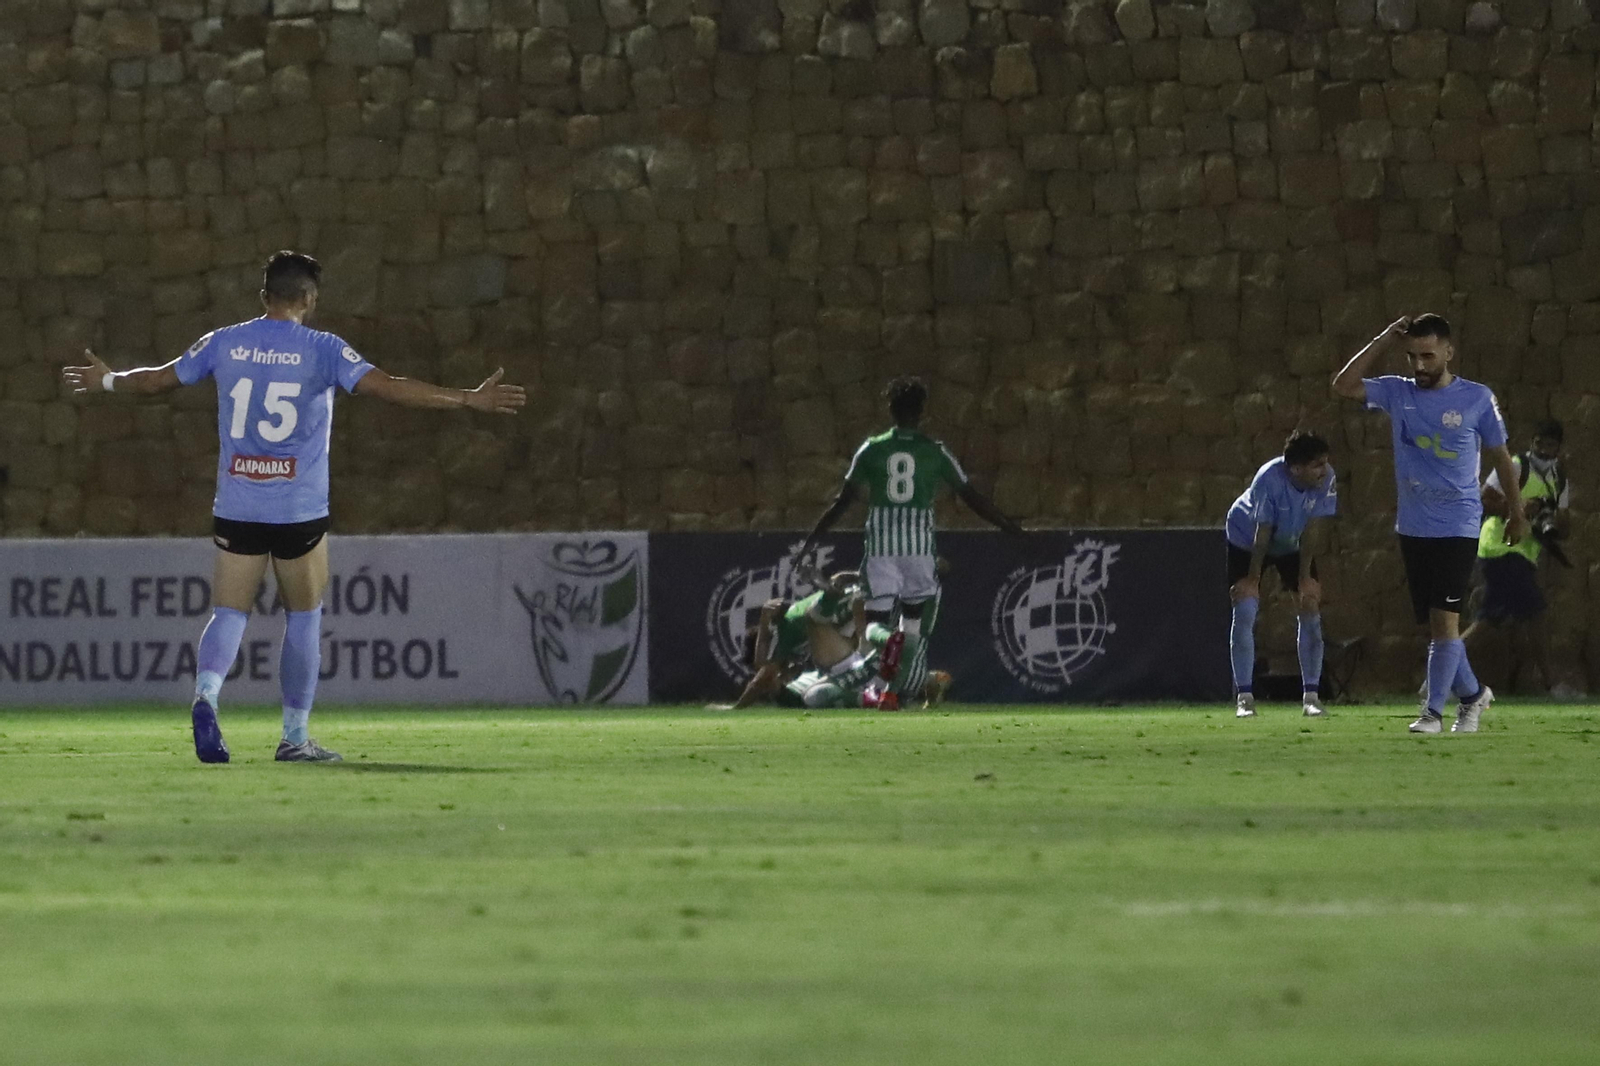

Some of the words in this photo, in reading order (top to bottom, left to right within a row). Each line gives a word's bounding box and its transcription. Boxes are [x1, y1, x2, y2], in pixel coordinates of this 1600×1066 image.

[252, 348, 301, 366] Infrico
[229, 377, 302, 443] 15
[234, 457, 291, 475] CAMPOARAS
[886, 451, 916, 504] 8
[10, 576, 118, 618] REAL
[0, 641, 198, 683] NDALUZA
